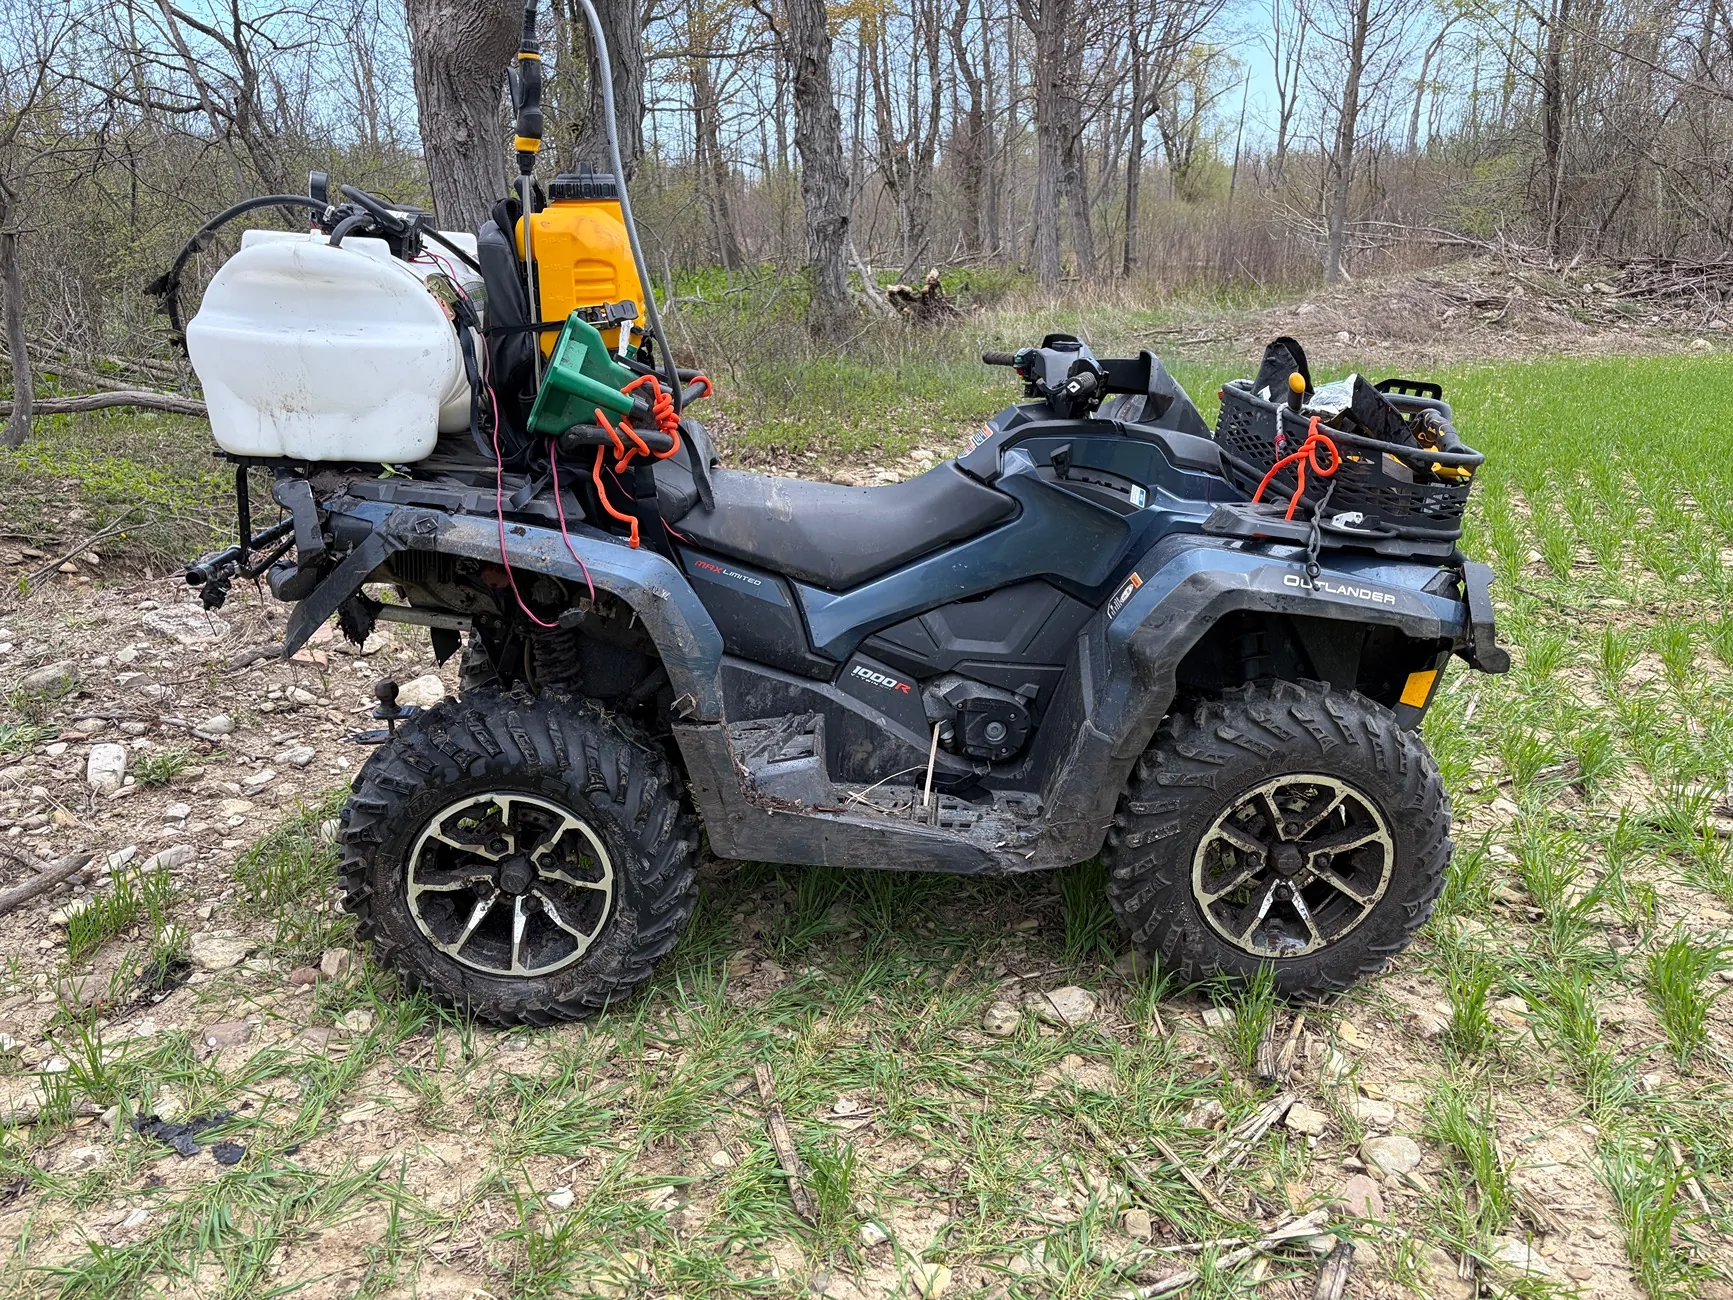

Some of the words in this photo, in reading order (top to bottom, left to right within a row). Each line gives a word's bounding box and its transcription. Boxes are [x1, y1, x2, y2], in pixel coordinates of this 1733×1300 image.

[694, 560, 723, 574] MAX
[722, 569, 762, 586] LIMITED
[1283, 574, 1396, 606] OUTLANDER
[852, 665, 911, 695] 1000R
